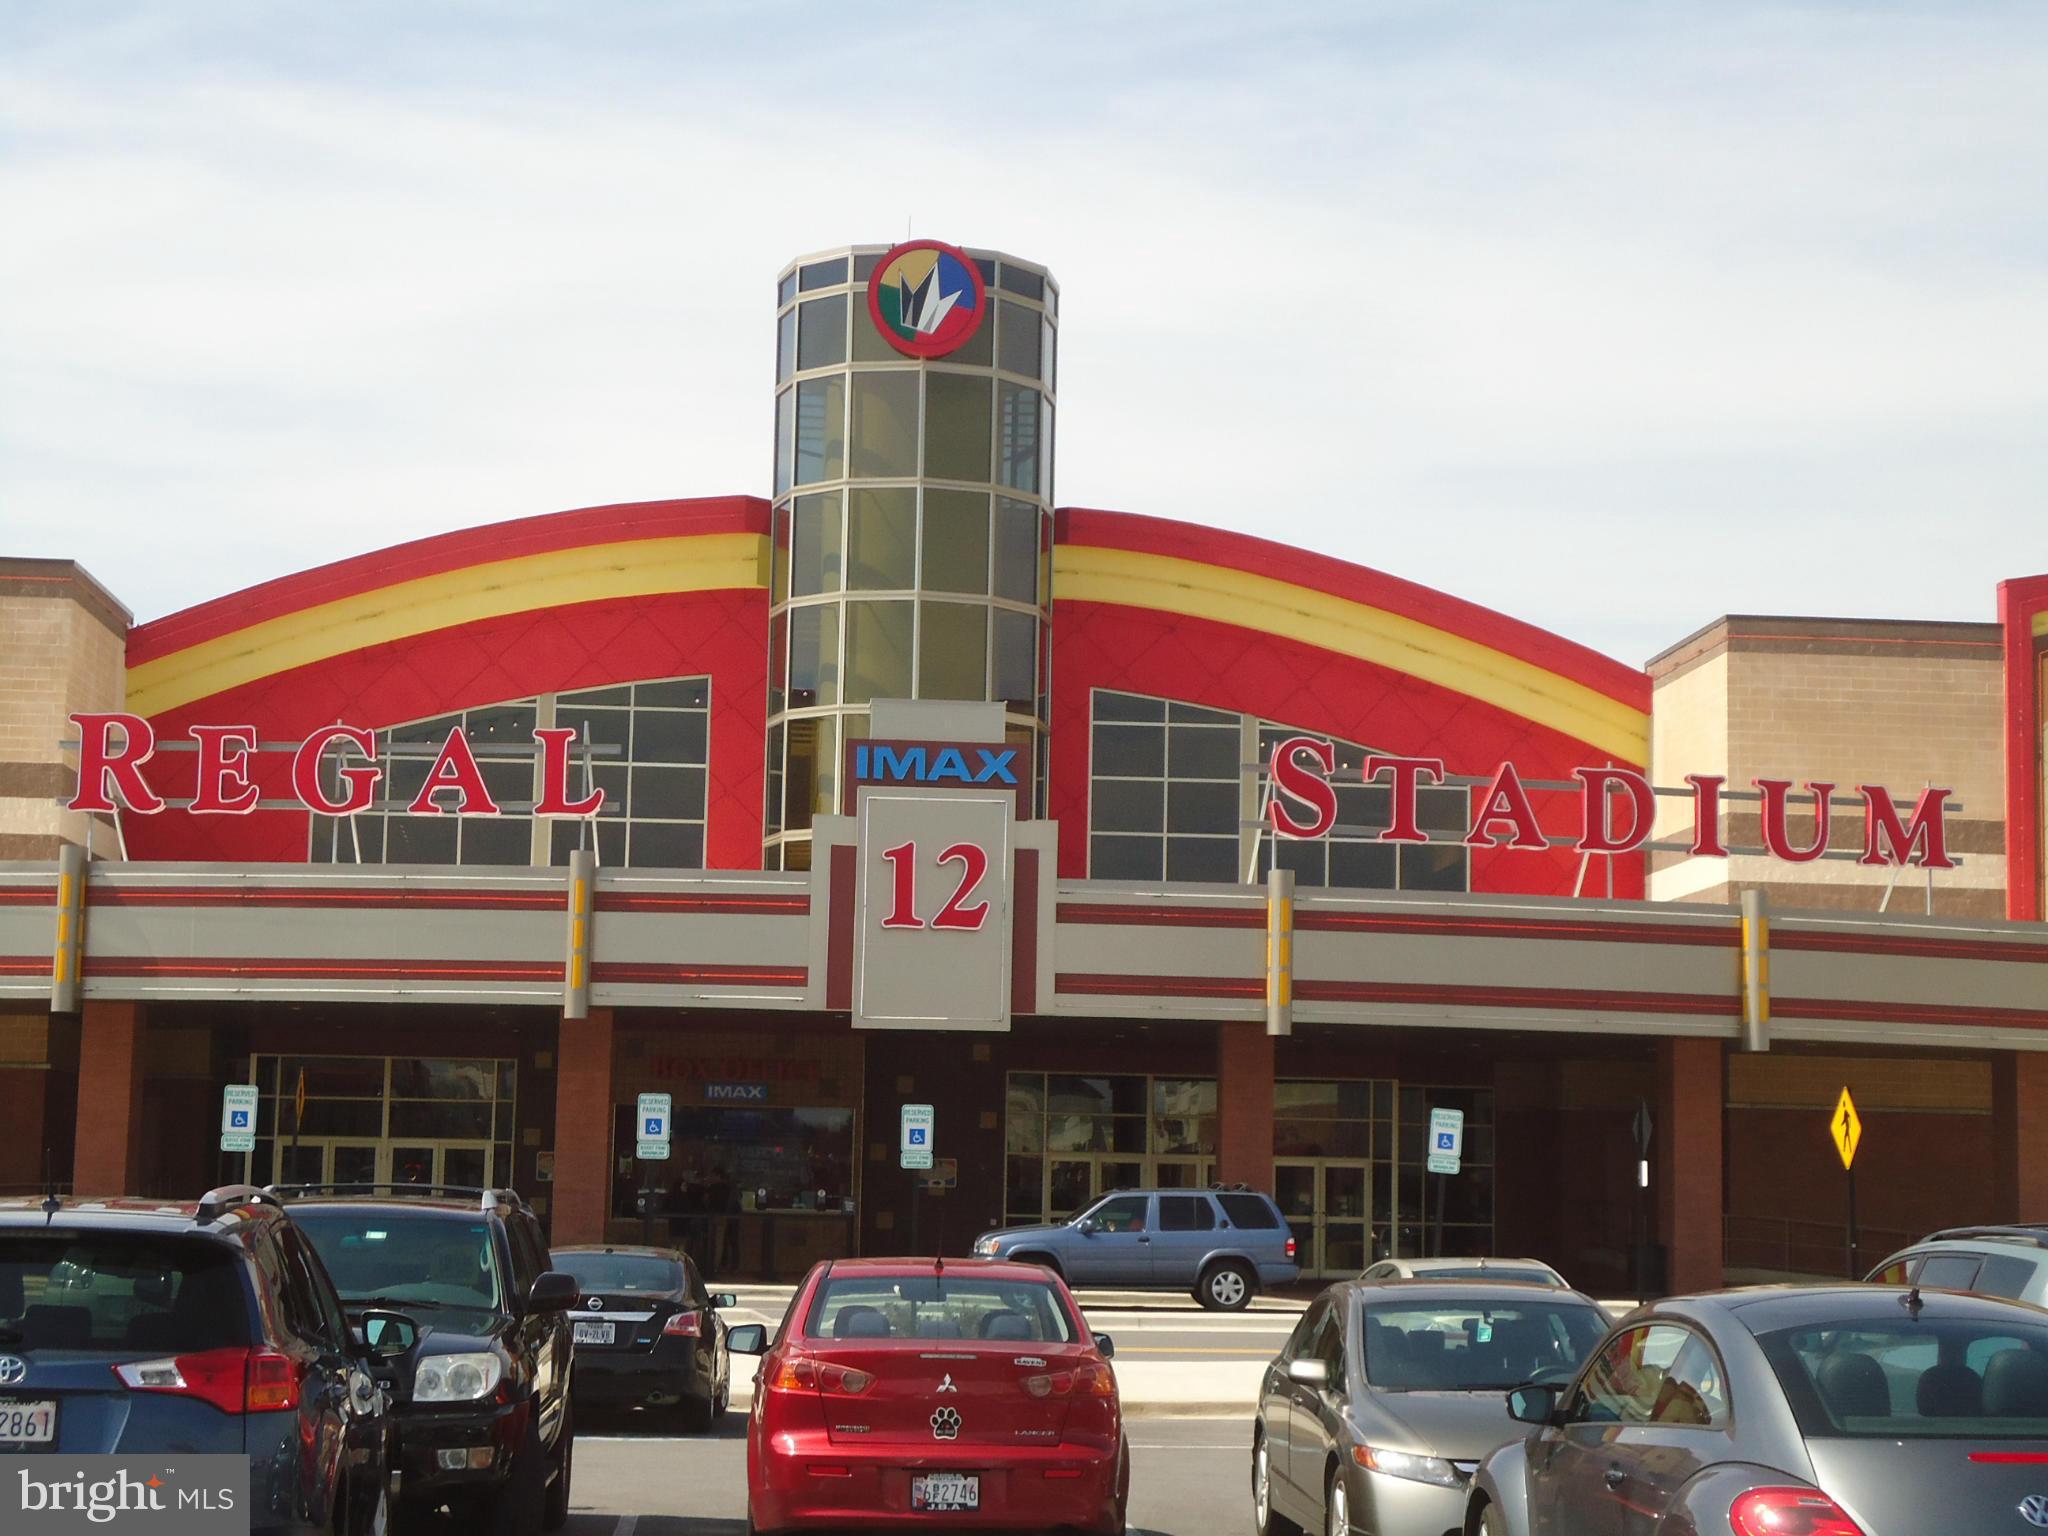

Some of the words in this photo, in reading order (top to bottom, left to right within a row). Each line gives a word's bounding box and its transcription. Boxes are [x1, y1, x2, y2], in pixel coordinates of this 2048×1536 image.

[67, 712, 604, 818] REGAL
[856, 745, 1019, 785] IMAX
[1268, 736, 1965, 869] STADIUM
[881, 840, 990, 930] 12
[708, 1085, 761, 1098] IMAX
